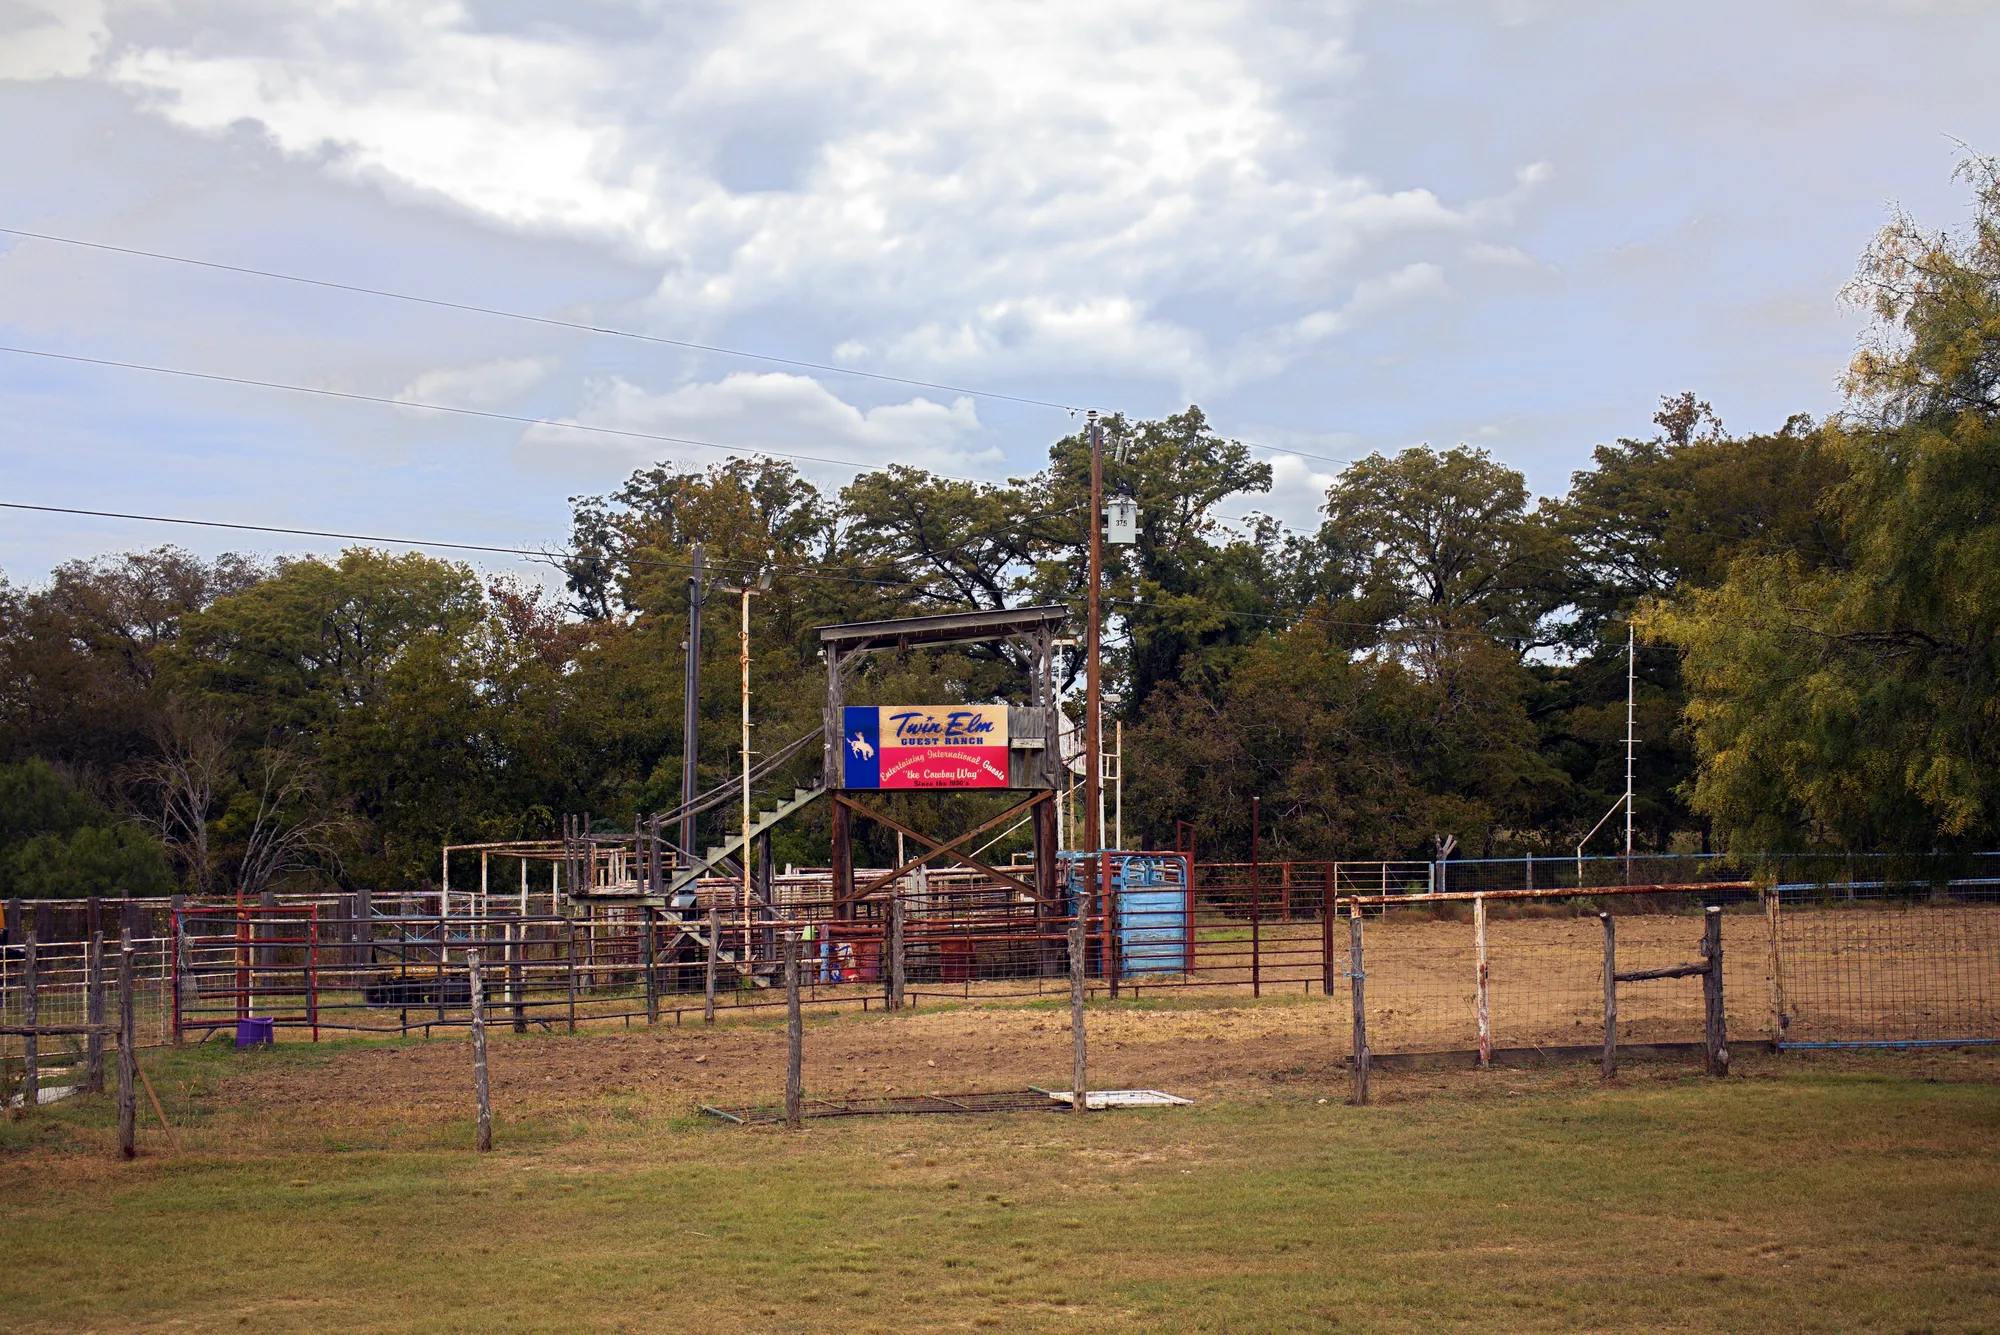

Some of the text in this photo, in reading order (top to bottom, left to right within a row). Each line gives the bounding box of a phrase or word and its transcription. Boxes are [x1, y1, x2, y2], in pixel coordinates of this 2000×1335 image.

[889, 712, 995, 738] Twin Elm
[901, 737, 984, 746] GUEST RANCH
[880, 750, 1005, 782] Entertaining International Guests
[923, 769, 955, 780] Cowboy
